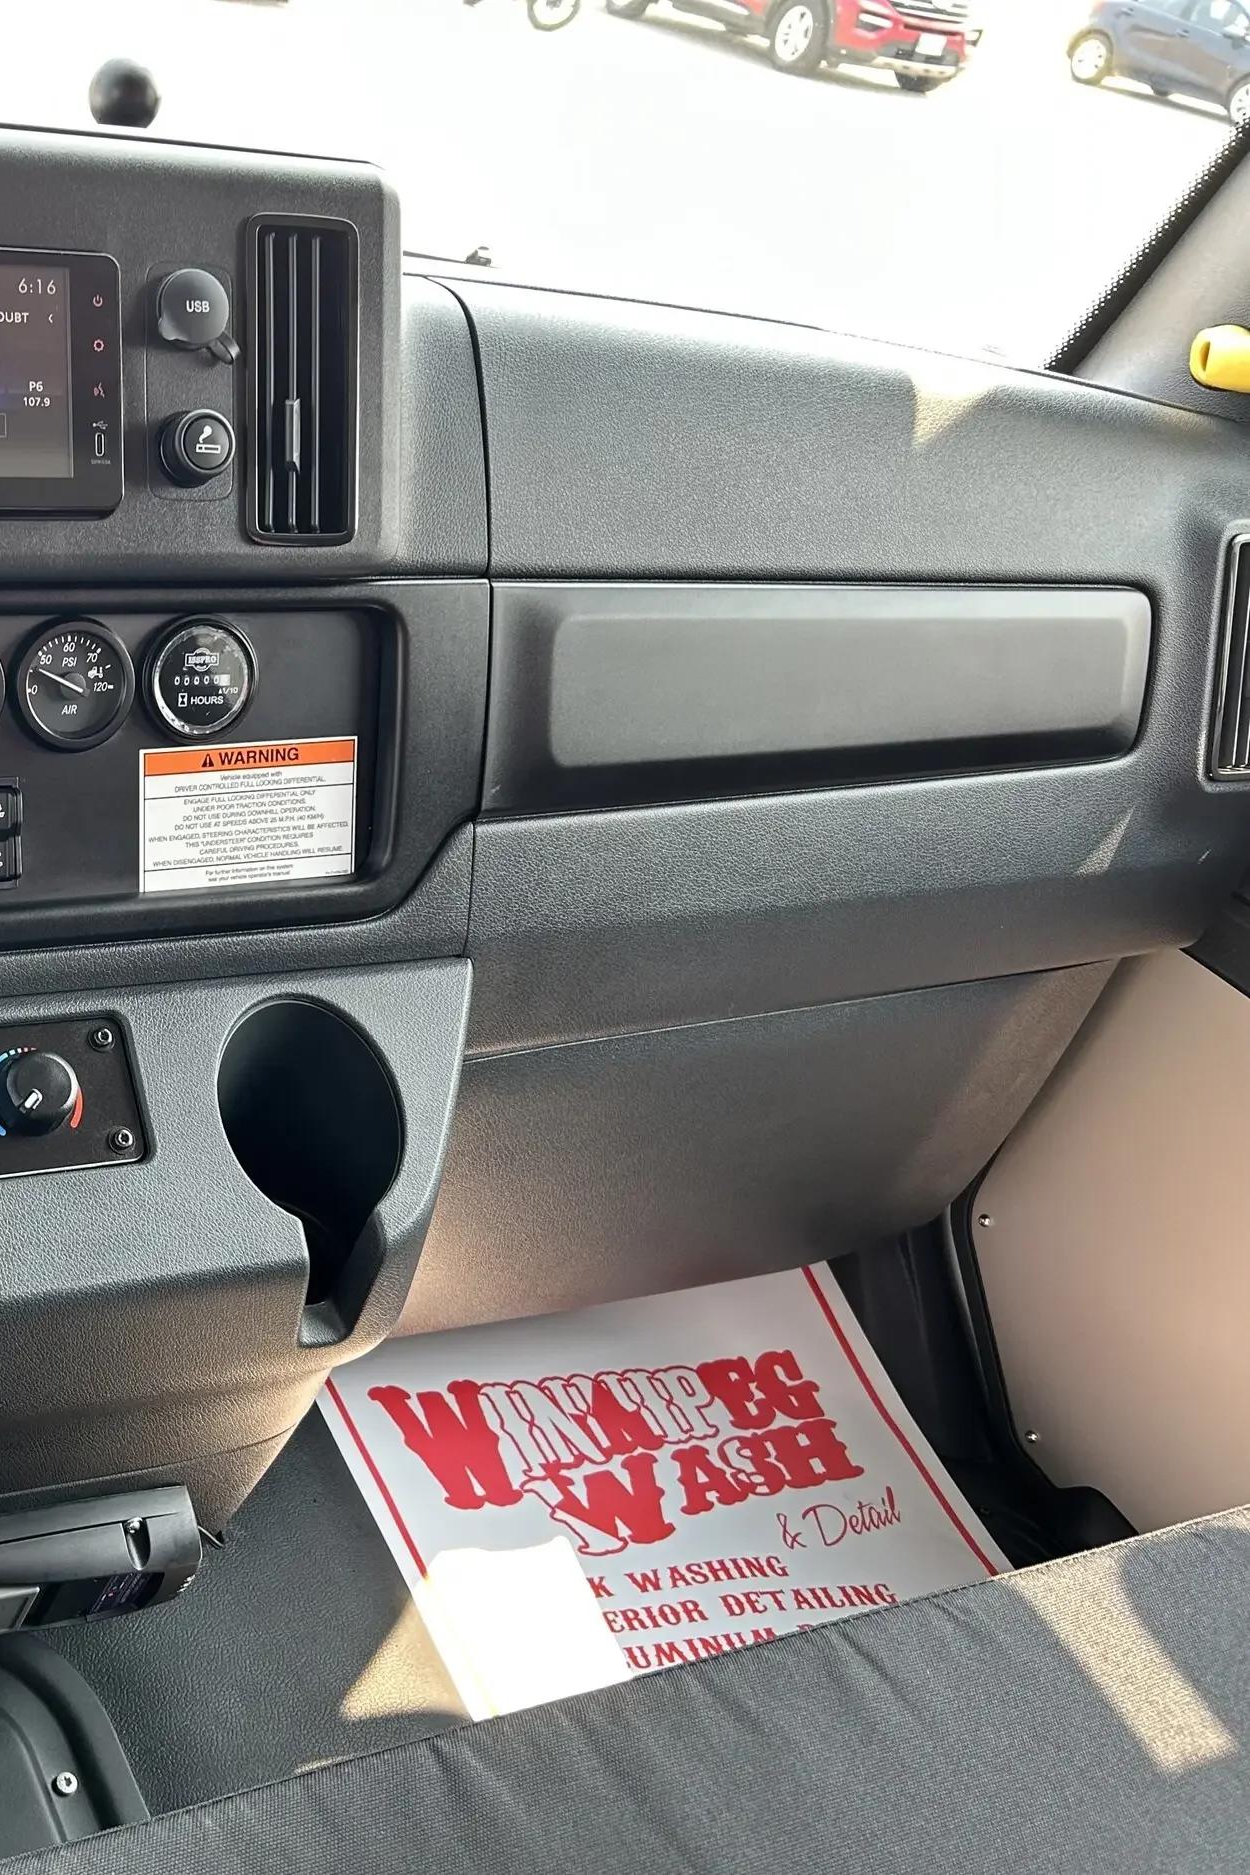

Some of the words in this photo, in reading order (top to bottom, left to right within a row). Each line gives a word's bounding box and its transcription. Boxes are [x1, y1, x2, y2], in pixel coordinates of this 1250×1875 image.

[18, 277, 57, 296] 6:16
[186, 300, 210, 313] USB
[29, 381, 44, 392] P6
[23, 396, 51, 408] 107.9
[63, 642, 76, 653] 60
[39, 654, 53, 665] 50
[62, 656, 77, 668] PSI
[86, 652, 98, 663] 70
[31, 685, 38, 695] 0
[93, 682, 108, 692] 120
[190, 696, 224, 705] HOURS
[61, 704, 77, 715] AIR
[218, 747, 299, 766] WARNING
[174, 784, 197, 792] DRIVER
[198, 781, 239, 790] CONTROLLED
[255, 778, 282, 786] LOCKING
[183, 797, 209, 805] ENGAGE
[236, 801, 266, 809] TRACTION
[221, 810, 245, 818] DURING
[247, 808, 278, 816] DOWNHILL
[222, 818, 246, 826] SPEEDS
[201, 829, 233, 838] STEERING
[184, 840, 199, 848] THIS
[152, 859, 171, 867] WHEN
[367, 1350, 824, 1510] WINNIPEG
[520, 1418, 865, 1557] WASH
[776, 1512, 807, 1549] &
[802, 1486, 901, 1547] Detail
[627, 1555, 790, 1593] WASHING
[602, 1599, 709, 1634] ERIOR
[718, 1582, 900, 1617] DETAILING
